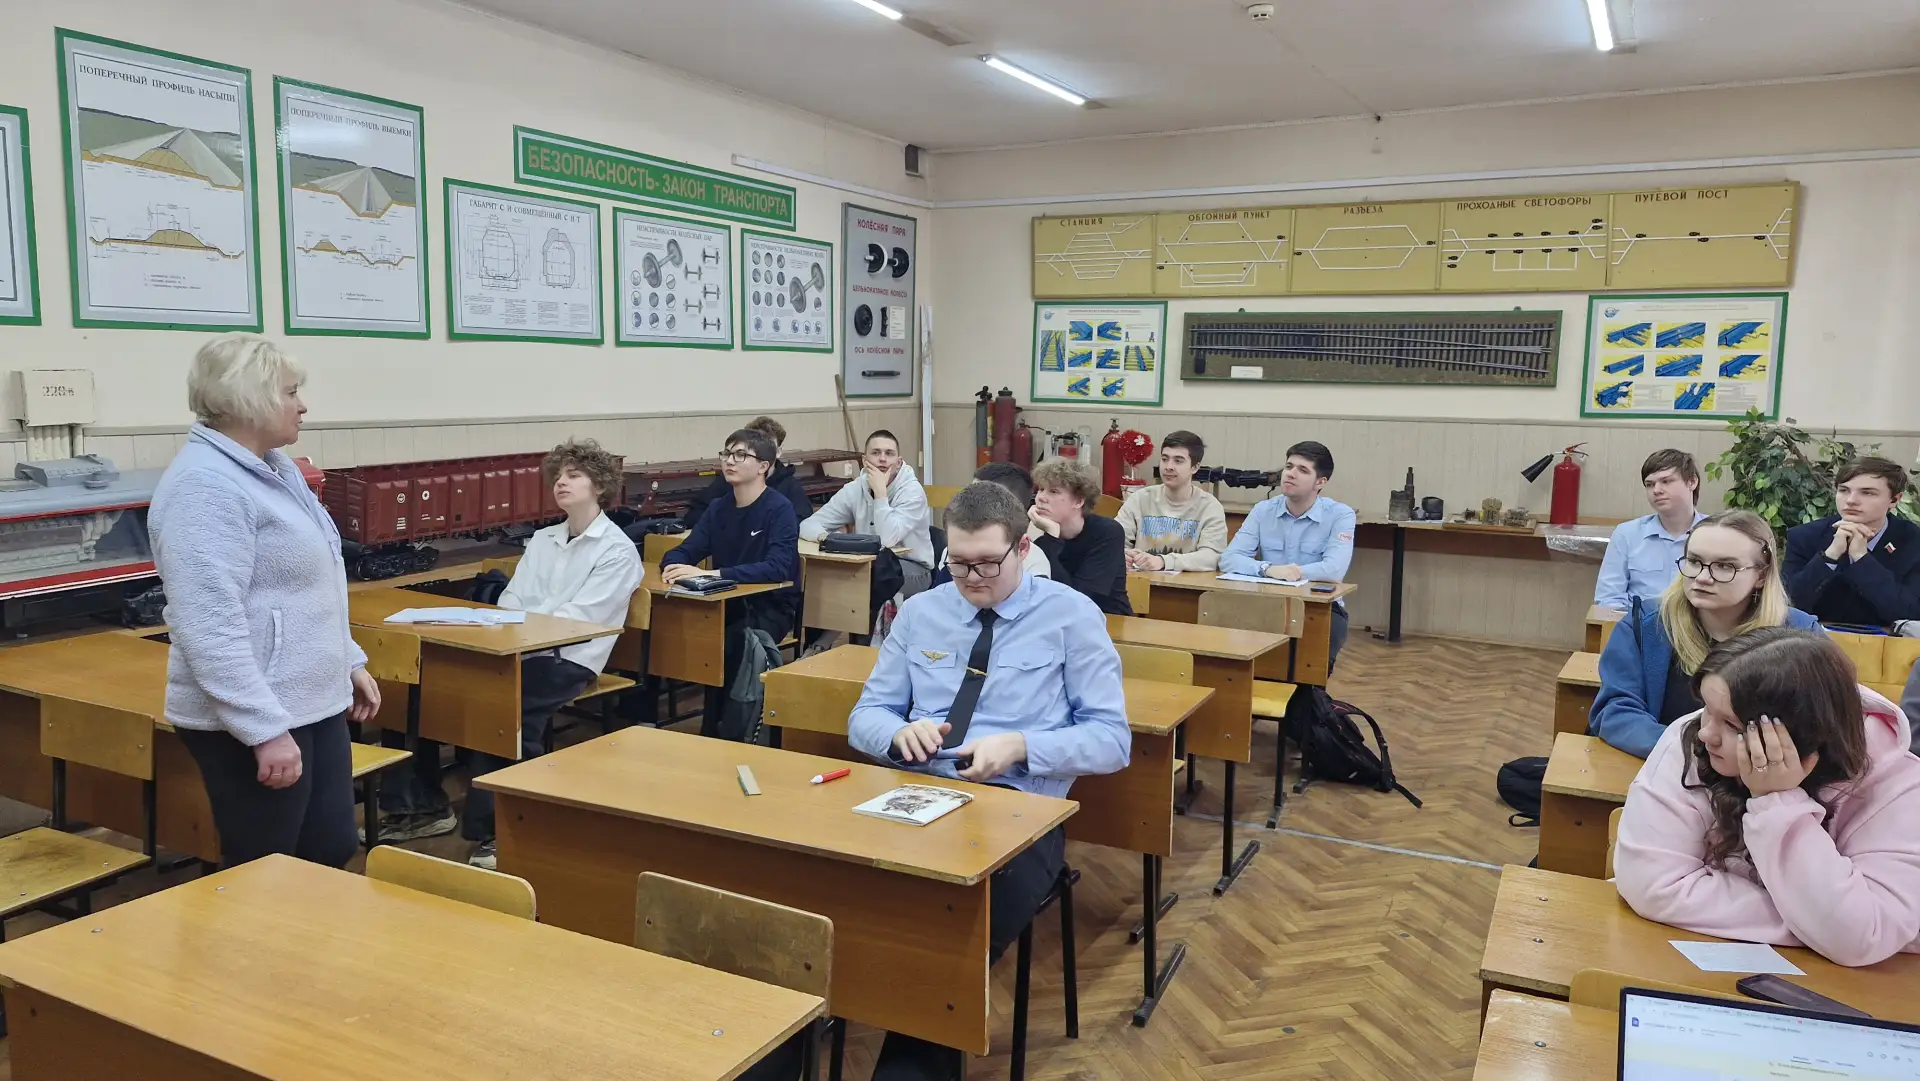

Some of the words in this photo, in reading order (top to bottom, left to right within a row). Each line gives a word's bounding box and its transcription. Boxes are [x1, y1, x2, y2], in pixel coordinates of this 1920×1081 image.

[79, 64, 148, 86] ПОПЕРЕЧНЫЙ
[152, 78, 195, 95] ПРОФИЛЬ
[198, 88, 236, 103] НАСЫПИ
[290, 107, 343, 123] ПОПЕРЕЧНЫЙ
[346, 117, 380, 131] ПРОФИЛЬ
[381, 124, 412, 138] ВЫЕМКИ
[661, 173, 706, 200] ЗАКОН
[713, 183, 788, 216] ТРАНСПОРТА
[1635, 190, 1687, 203] ПУТЕВОЙ
[1697, 189, 1729, 200] ПОСТ
[469, 199, 497, 210] ГАБАРИТ
[1456, 200, 1516, 211] ПРОХОДНЫЕ
[1524, 197, 1592, 207] СВЕТОФОРЫ
[1060, 217, 1103, 227] СТАНЦИЯ
[1188, 210, 1238, 222] ОБГОННЫЙ
[1243, 211, 1271, 219] ПУНКТ
[891, 226, 906, 237] ПАРА
